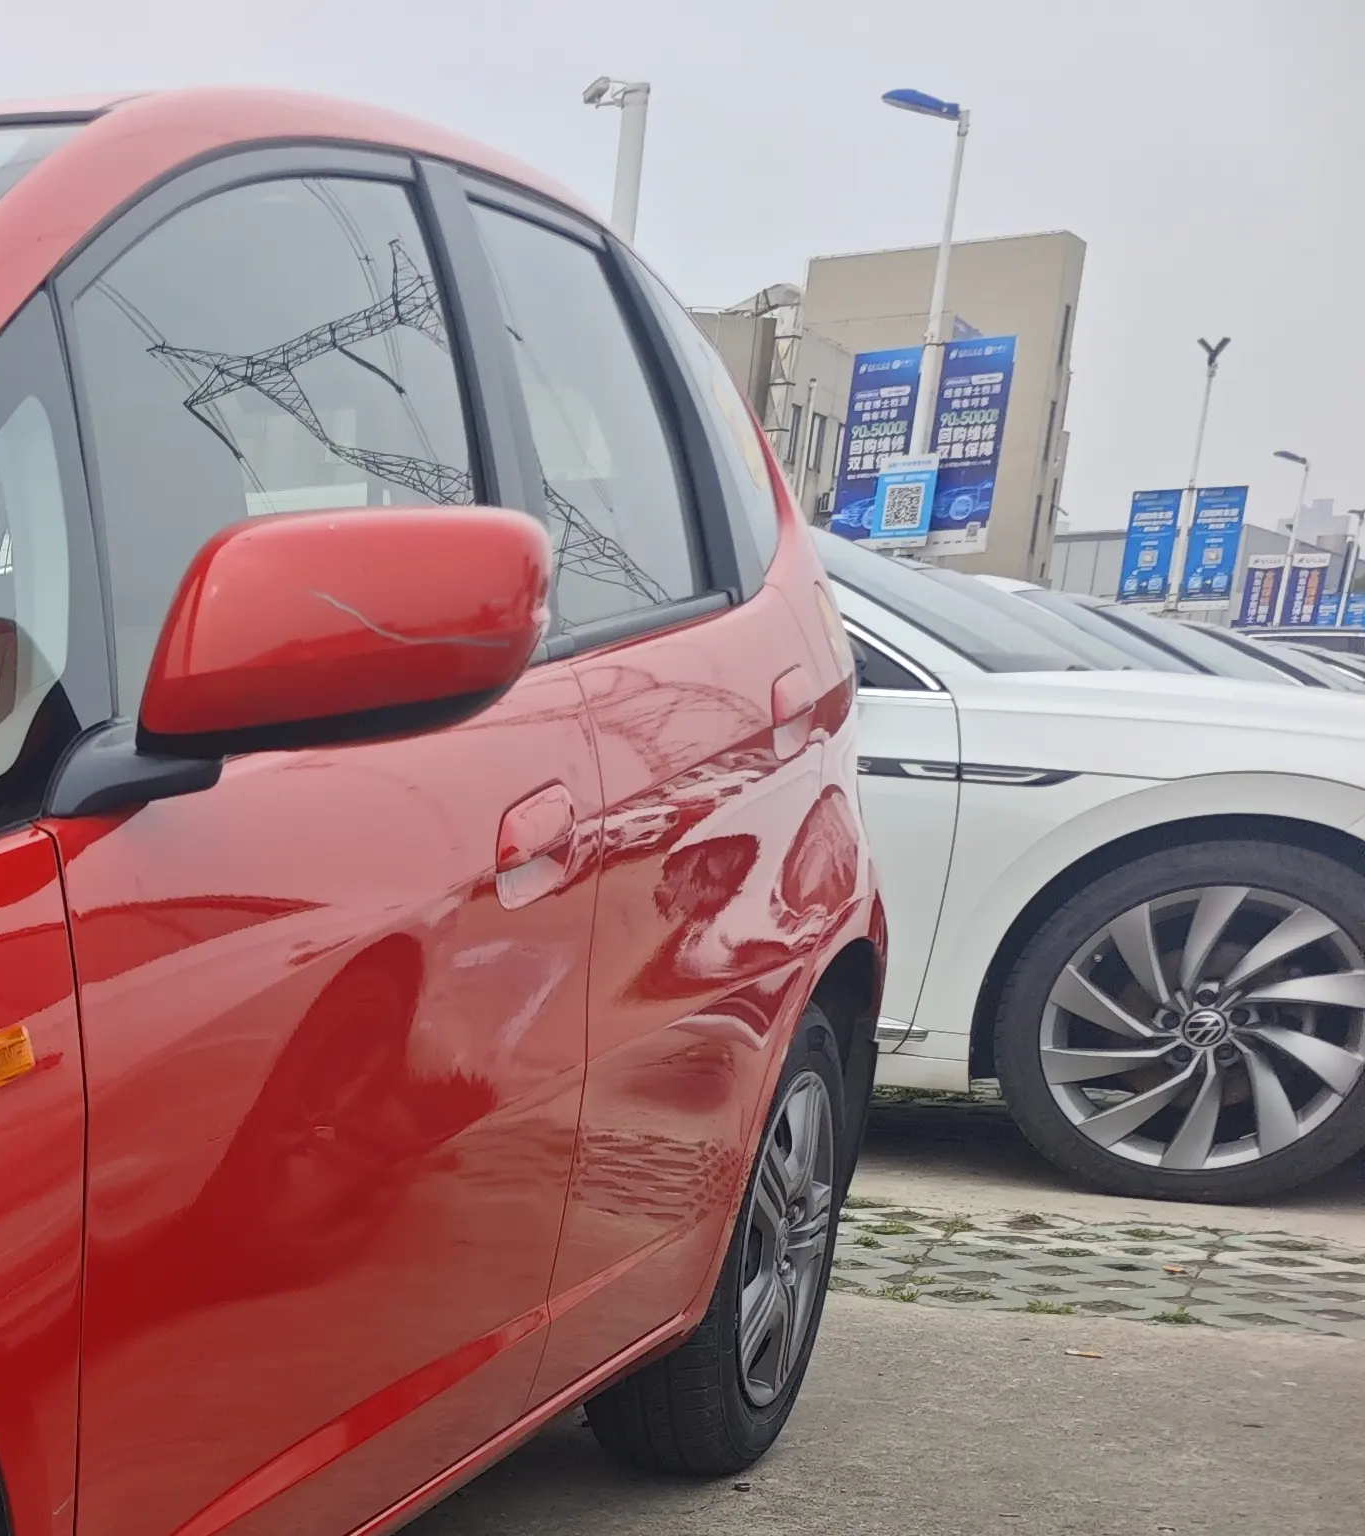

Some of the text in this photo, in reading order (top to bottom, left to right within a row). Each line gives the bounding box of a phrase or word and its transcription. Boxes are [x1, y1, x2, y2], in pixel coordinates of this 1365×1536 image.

[937, 424, 997, 444] 回购维修
[849, 436, 906, 455] 回购维修
